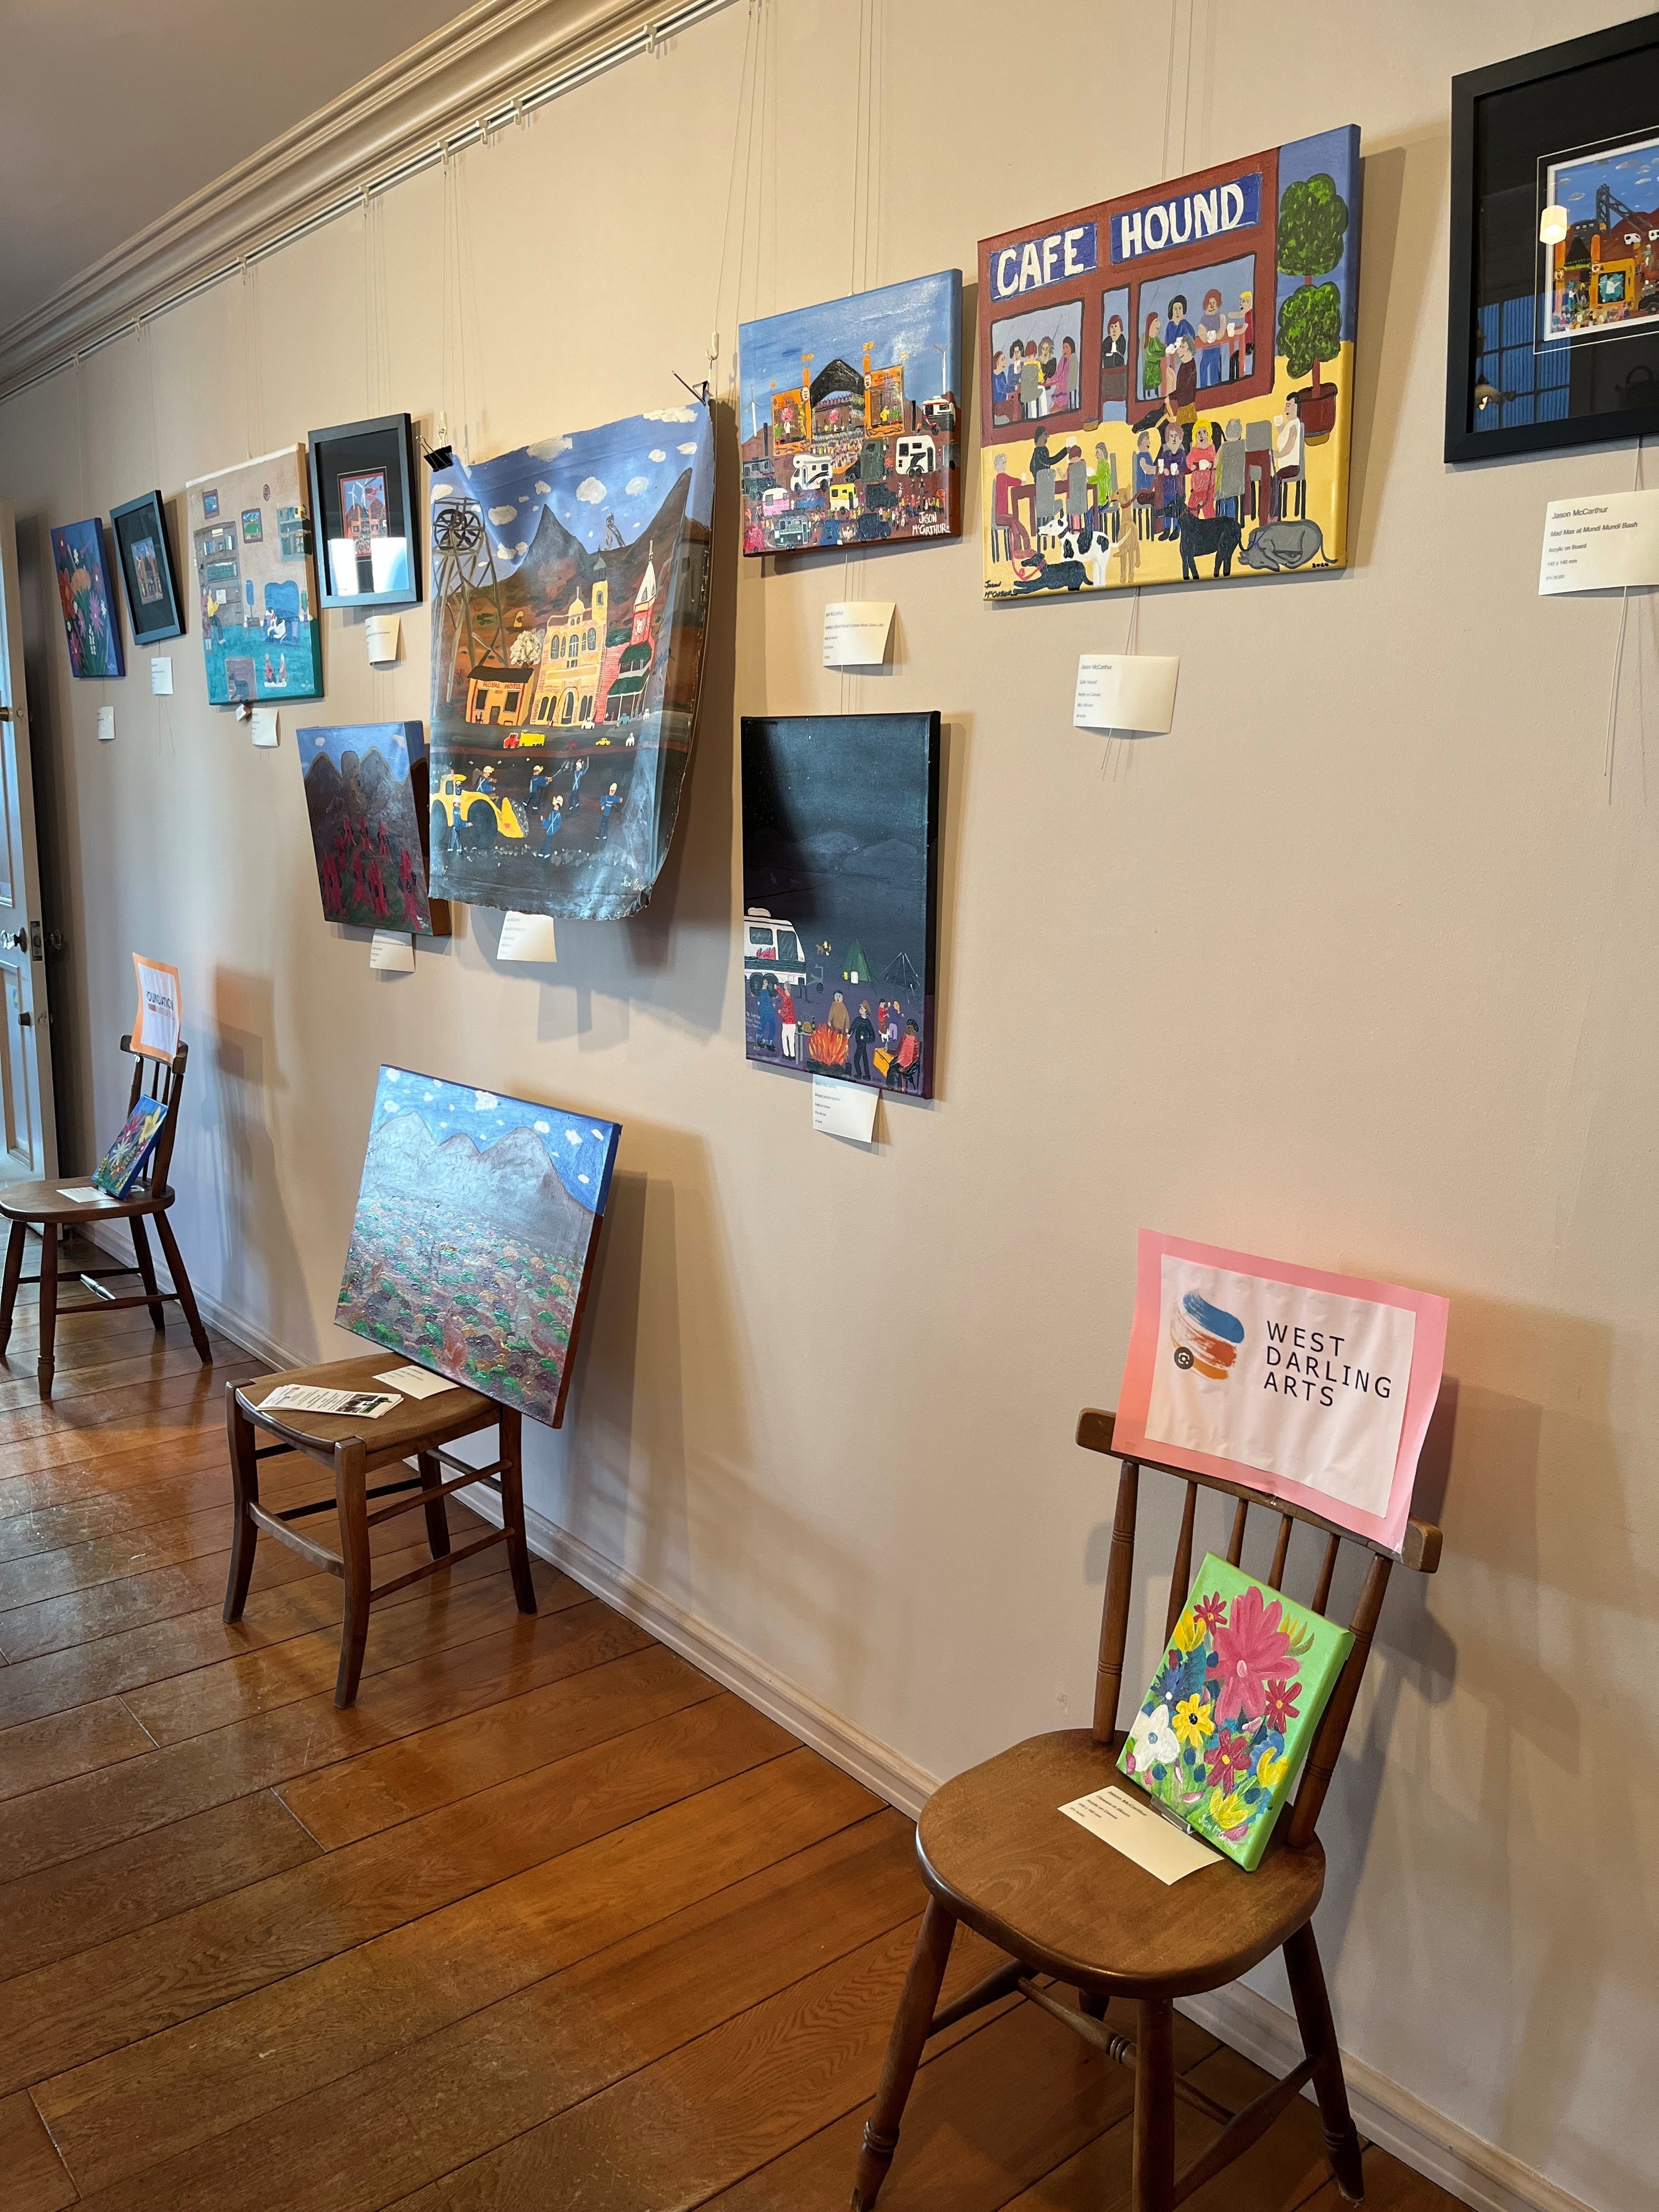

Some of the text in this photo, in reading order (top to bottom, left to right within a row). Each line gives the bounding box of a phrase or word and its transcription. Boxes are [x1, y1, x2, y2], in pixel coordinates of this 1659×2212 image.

[997, 183, 1245, 296] CAFE HOUND
[1572, 507, 1609, 516] McCarthur
[1267, 1320, 1345, 1357] WEST
[1263, 1372, 1334, 1407] ARTS
[1266, 1346, 1392, 1398] DARLING
